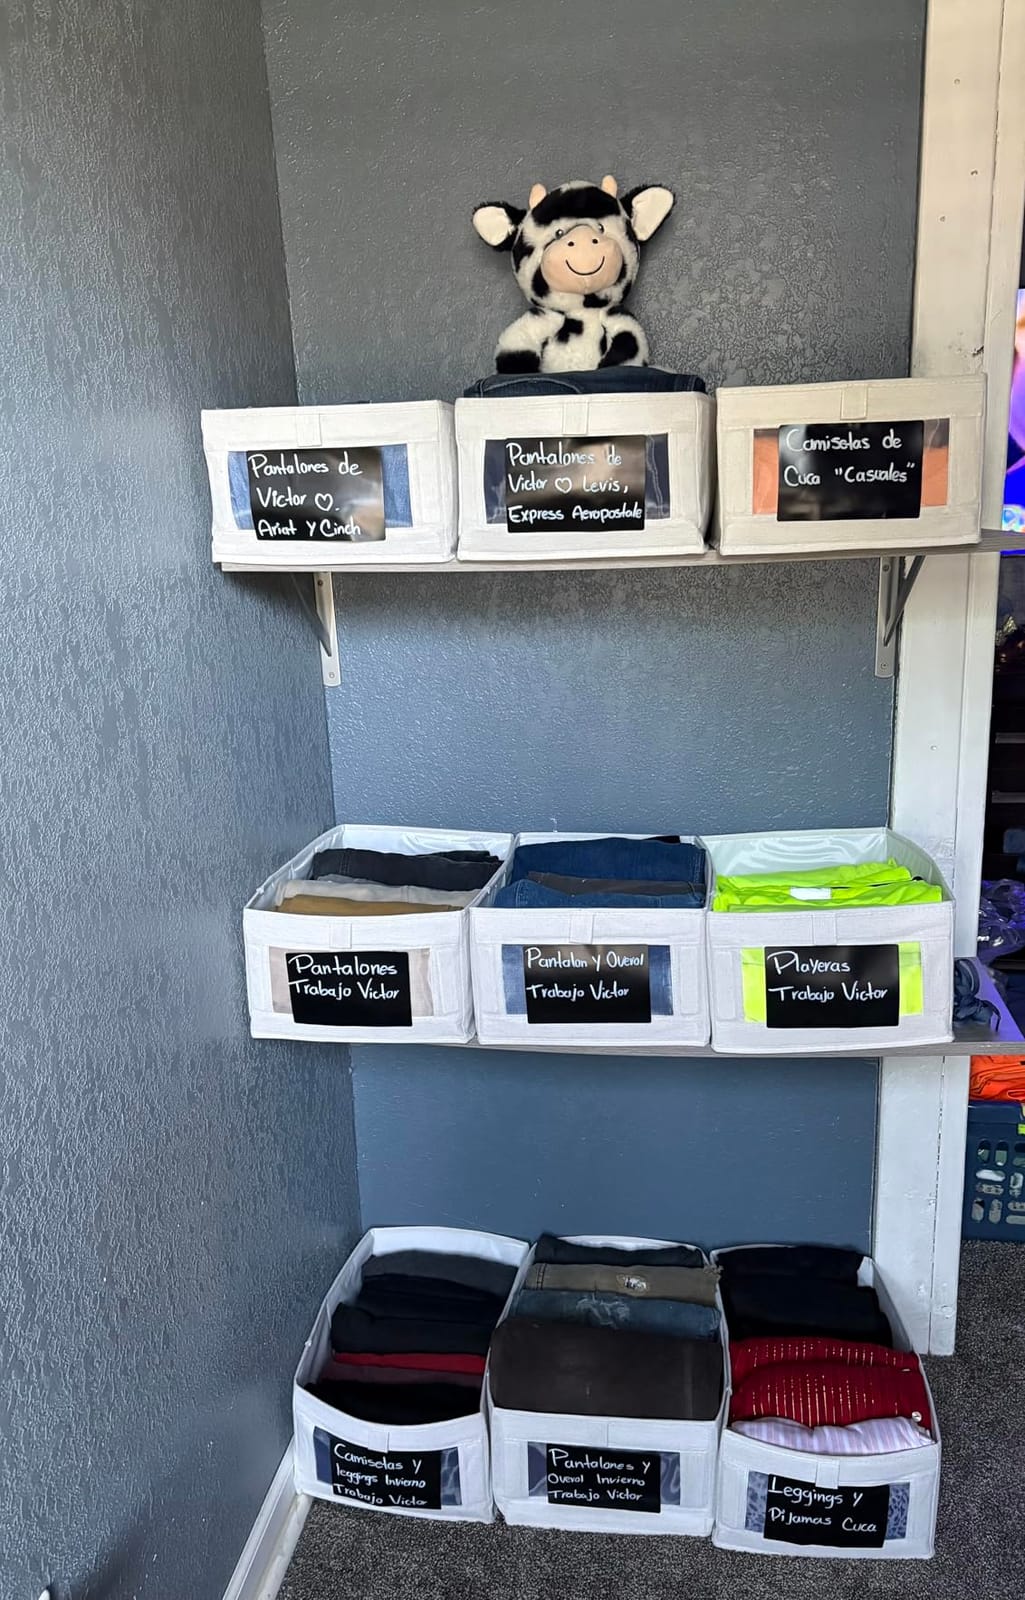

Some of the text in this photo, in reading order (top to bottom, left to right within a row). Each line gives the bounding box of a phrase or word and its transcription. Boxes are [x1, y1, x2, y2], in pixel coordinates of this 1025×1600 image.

[786, 429, 901, 451] Camisetas de
[248, 451, 363, 478] Pantalones de
[506, 441, 622, 466] Pantalones de
[508, 471, 548, 493] Victor
[784, 465, 820, 487] Cuca
[256, 486, 306, 507] Victor
[508, 502, 642, 524] Express Aeropostale
[257, 519, 297, 536] Ariat
[320, 516, 361, 537] Cinch
[288, 954, 397, 975] Pantalones
[525, 947, 587, 968] Pantalon
[767, 951, 850, 975] Playeras
[288, 978, 400, 1000] Trabajo Victor
[526, 980, 629, 1001] Trabajo Victor
[768, 980, 888, 1003] Trabajo Victor
[334, 1443, 403, 1470] Camisetas
[549, 1448, 634, 1470] Pantalones
[597, 1473, 645, 1486] Invierno
[333, 1483, 427, 1505] Trabajo Victor
[548, 1488, 642, 1501] Trabajo Victor
[768, 1477, 843, 1508] Leggings
[842, 1517, 877, 1532] Cuca
